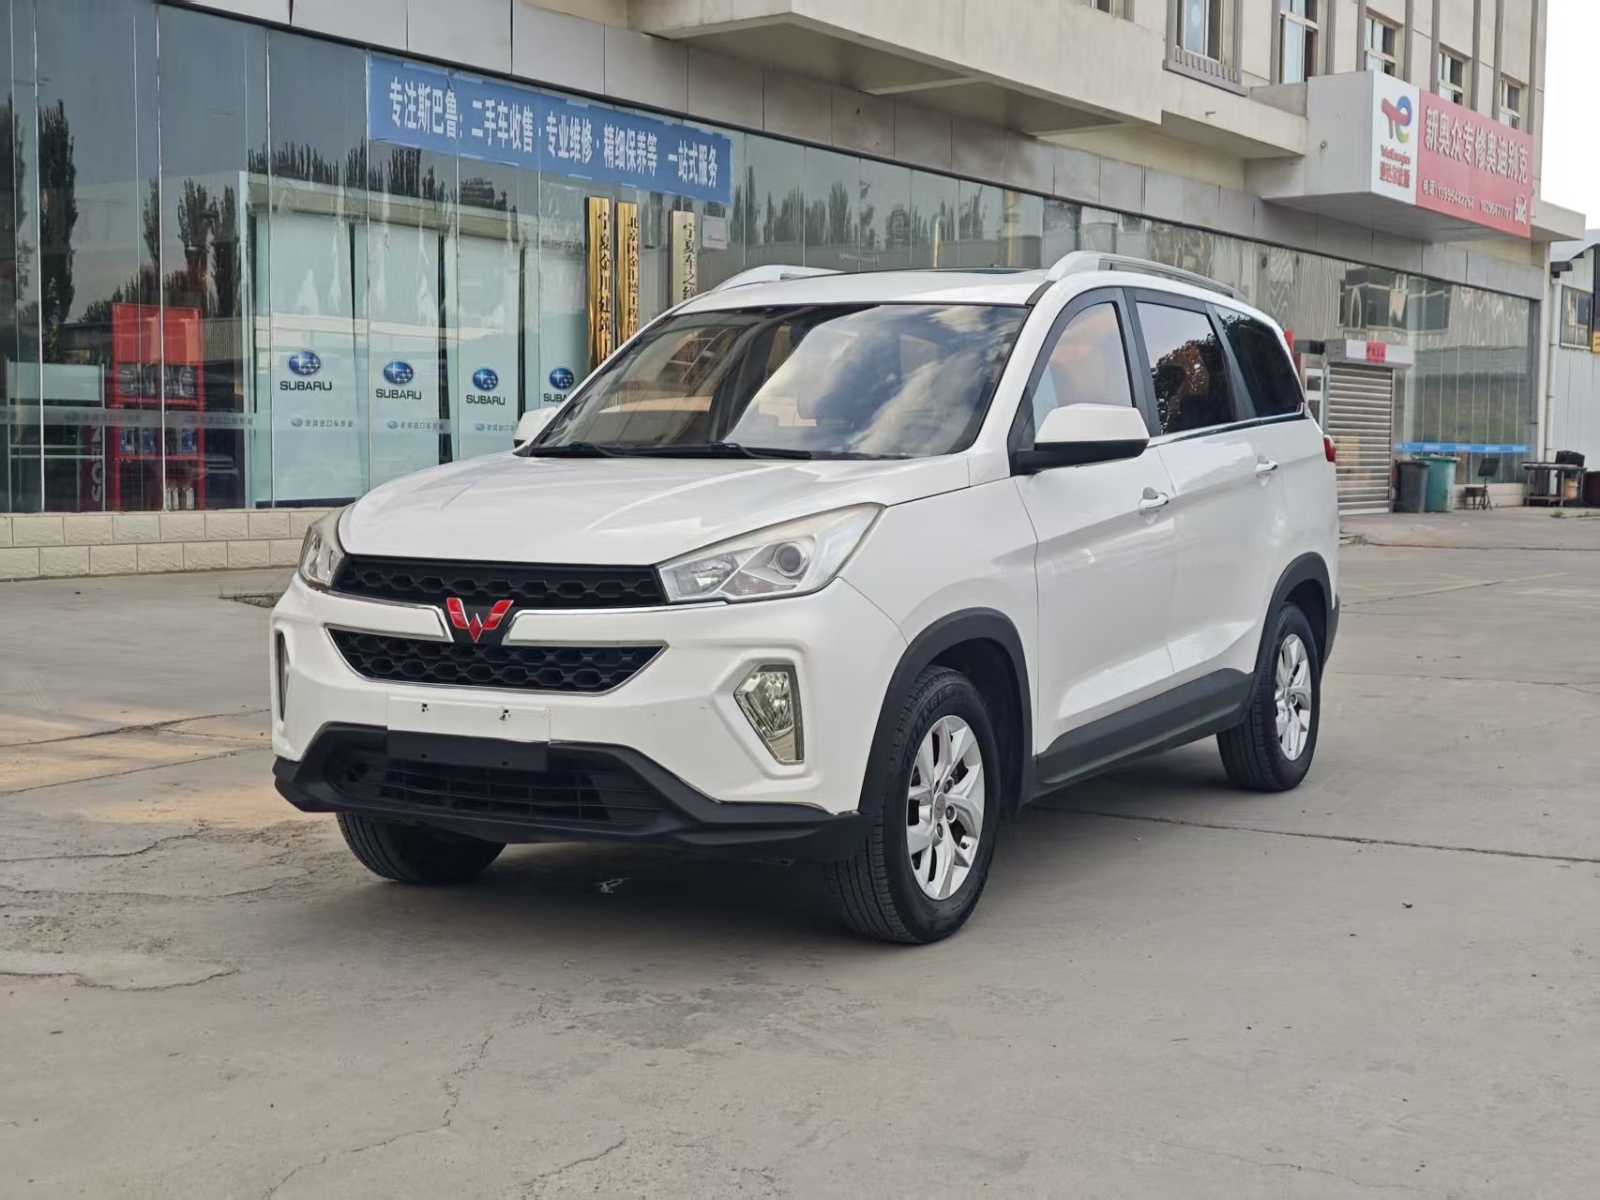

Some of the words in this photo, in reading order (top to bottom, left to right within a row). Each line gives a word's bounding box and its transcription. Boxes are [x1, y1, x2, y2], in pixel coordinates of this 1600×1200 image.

[279, 380, 333, 391] SUBARU
[375, 388, 422, 400] SUBARU
[543, 393, 568, 403] SUBA
[465, 394, 506, 406] SUBARU
